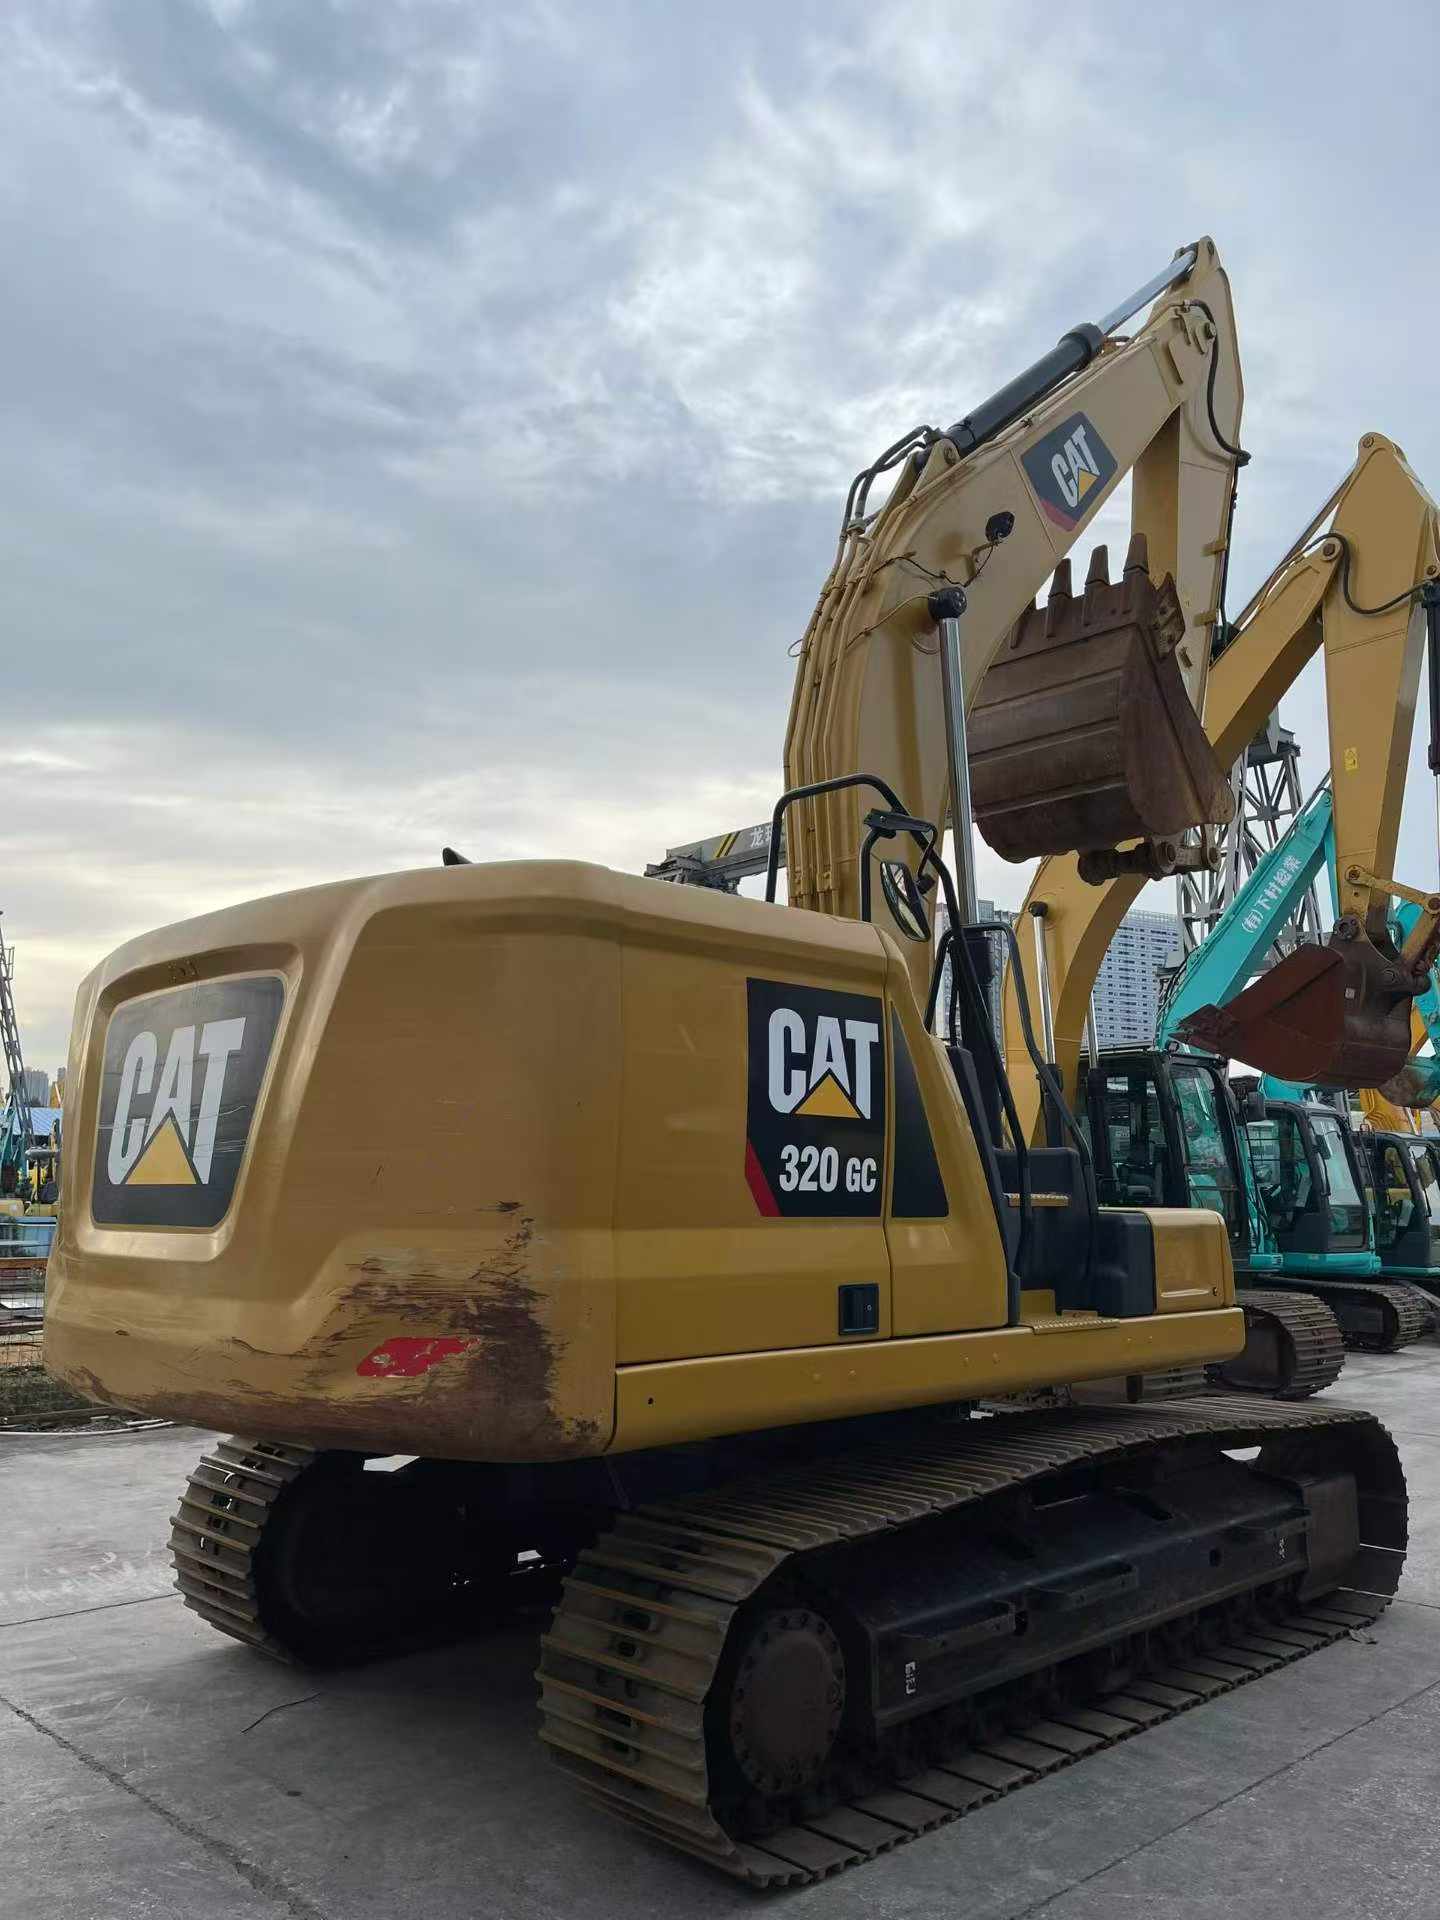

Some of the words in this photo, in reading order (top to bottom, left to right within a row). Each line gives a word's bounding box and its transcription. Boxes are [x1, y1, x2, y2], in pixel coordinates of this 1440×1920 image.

[1051, 424, 1100, 507] CAT
[108, 1017, 247, 1185] CAT
[768, 1008, 879, 1119] CAT
[779, 1144, 837, 1192] 320
[845, 1157, 877, 1193] GC
